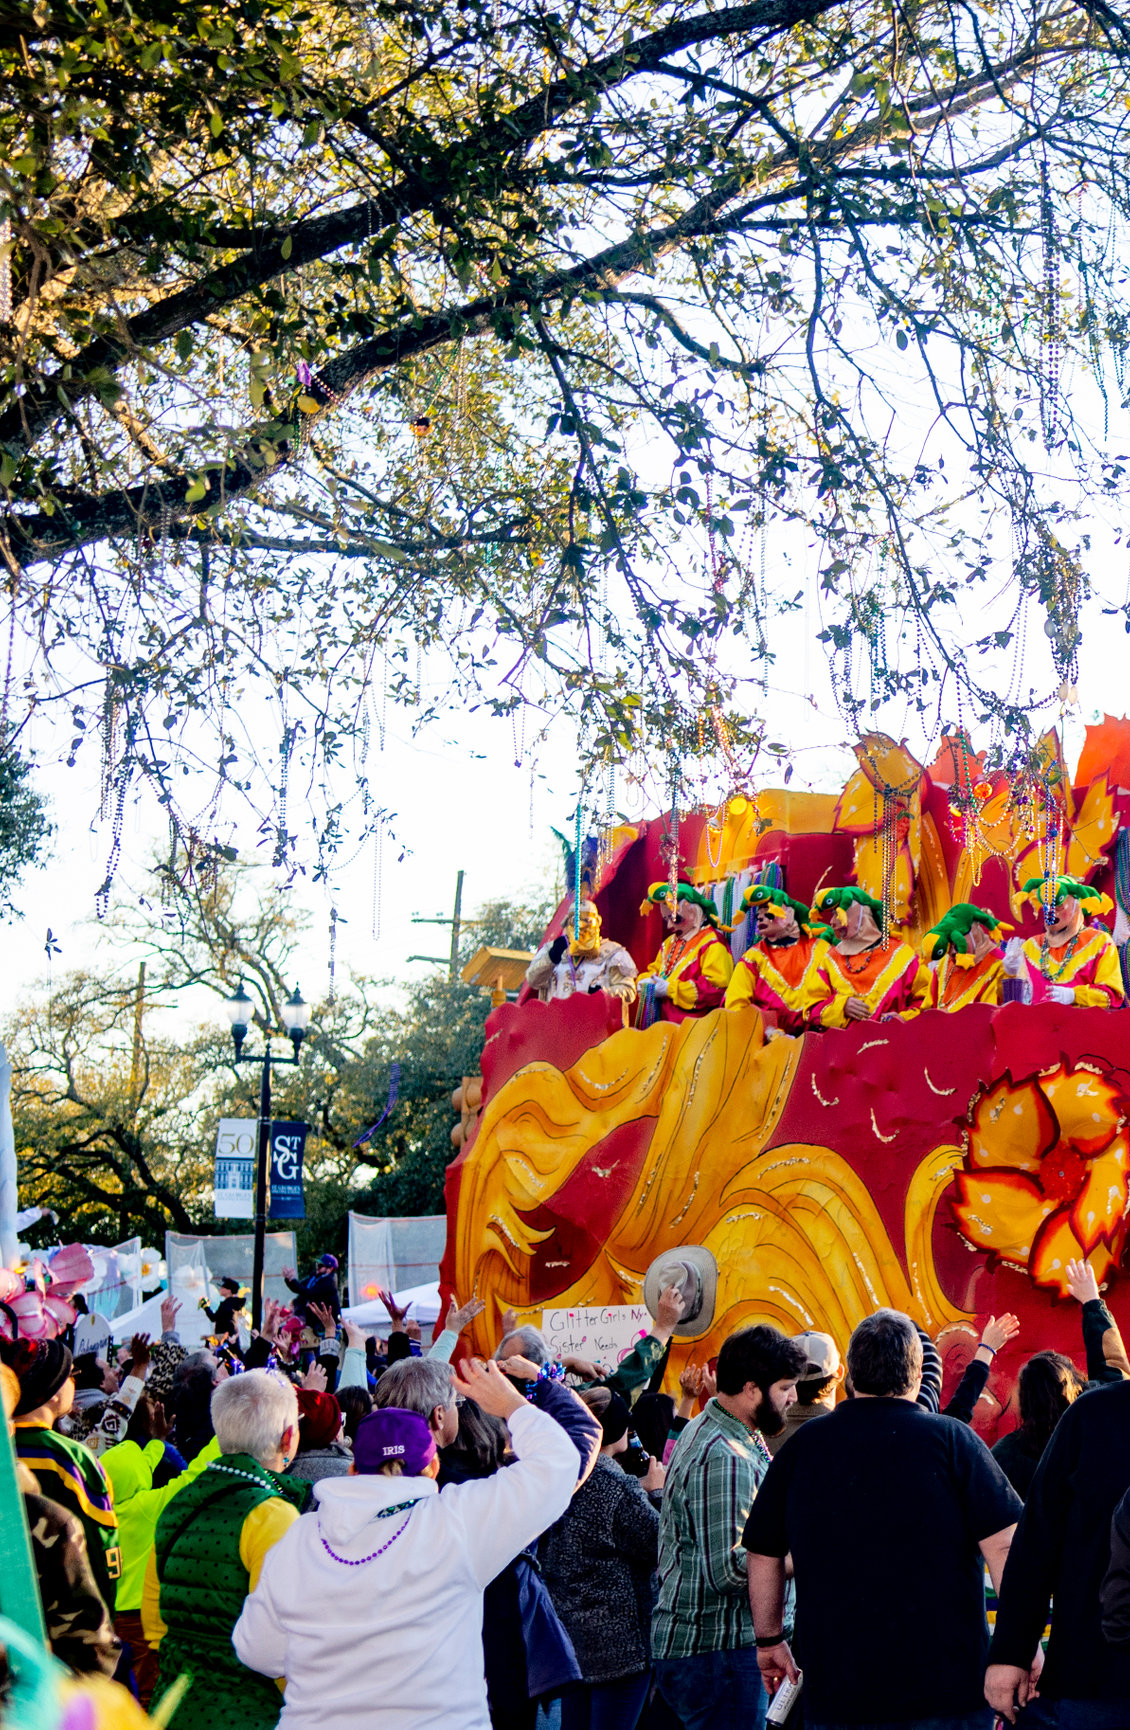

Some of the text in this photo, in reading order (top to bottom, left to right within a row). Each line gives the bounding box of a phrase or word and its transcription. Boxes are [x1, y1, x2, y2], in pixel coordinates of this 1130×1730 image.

[218, 1133, 254, 1154] 50
[550, 1309, 598, 1331] Glitter
[600, 1308, 626, 1324] Girls
[550, 1334, 618, 1354] Sister Needs
[382, 1445, 405, 1456] IRIS
